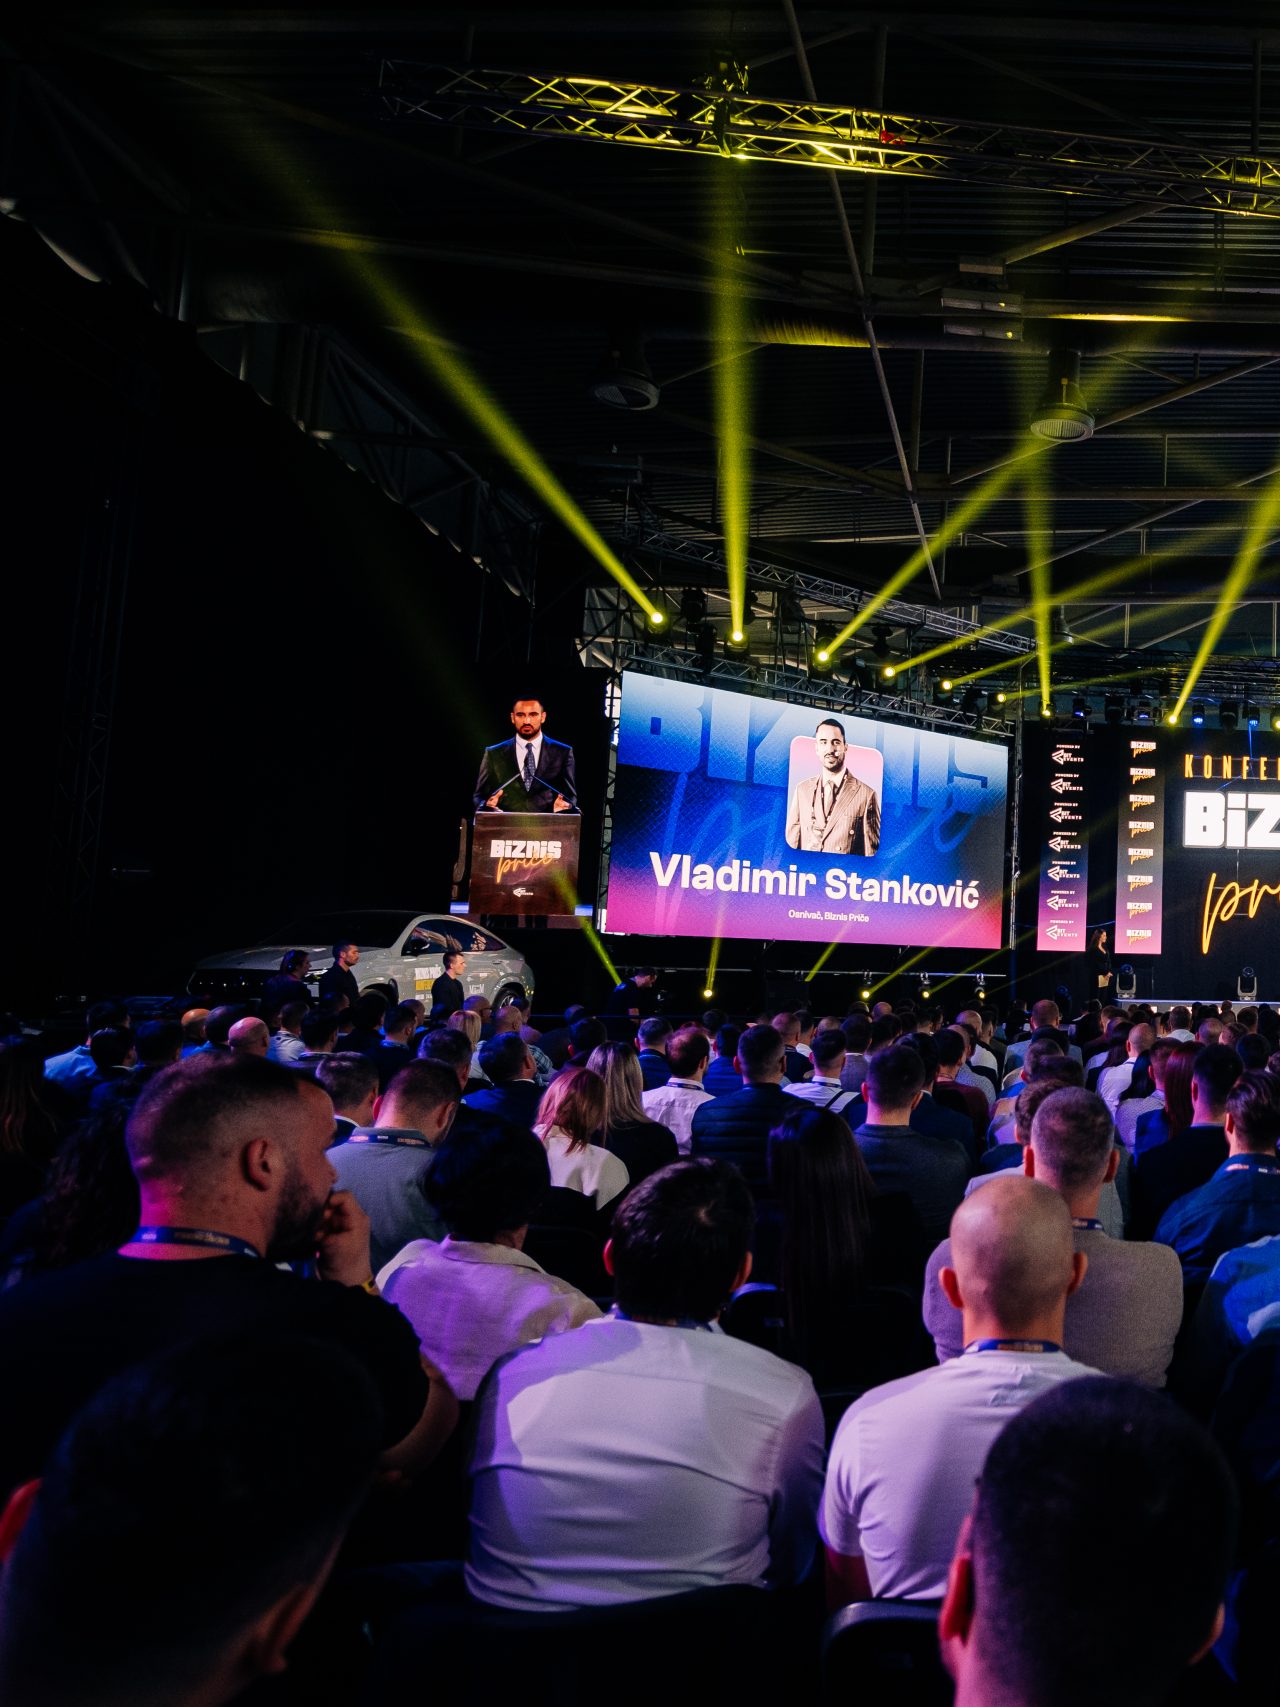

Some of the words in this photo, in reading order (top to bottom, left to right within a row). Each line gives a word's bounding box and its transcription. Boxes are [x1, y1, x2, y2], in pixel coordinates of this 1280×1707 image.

[650, 851, 816, 897] Vladimir
[825, 868, 979, 909] Stanković
[824, 912, 848, 921] Biznis
